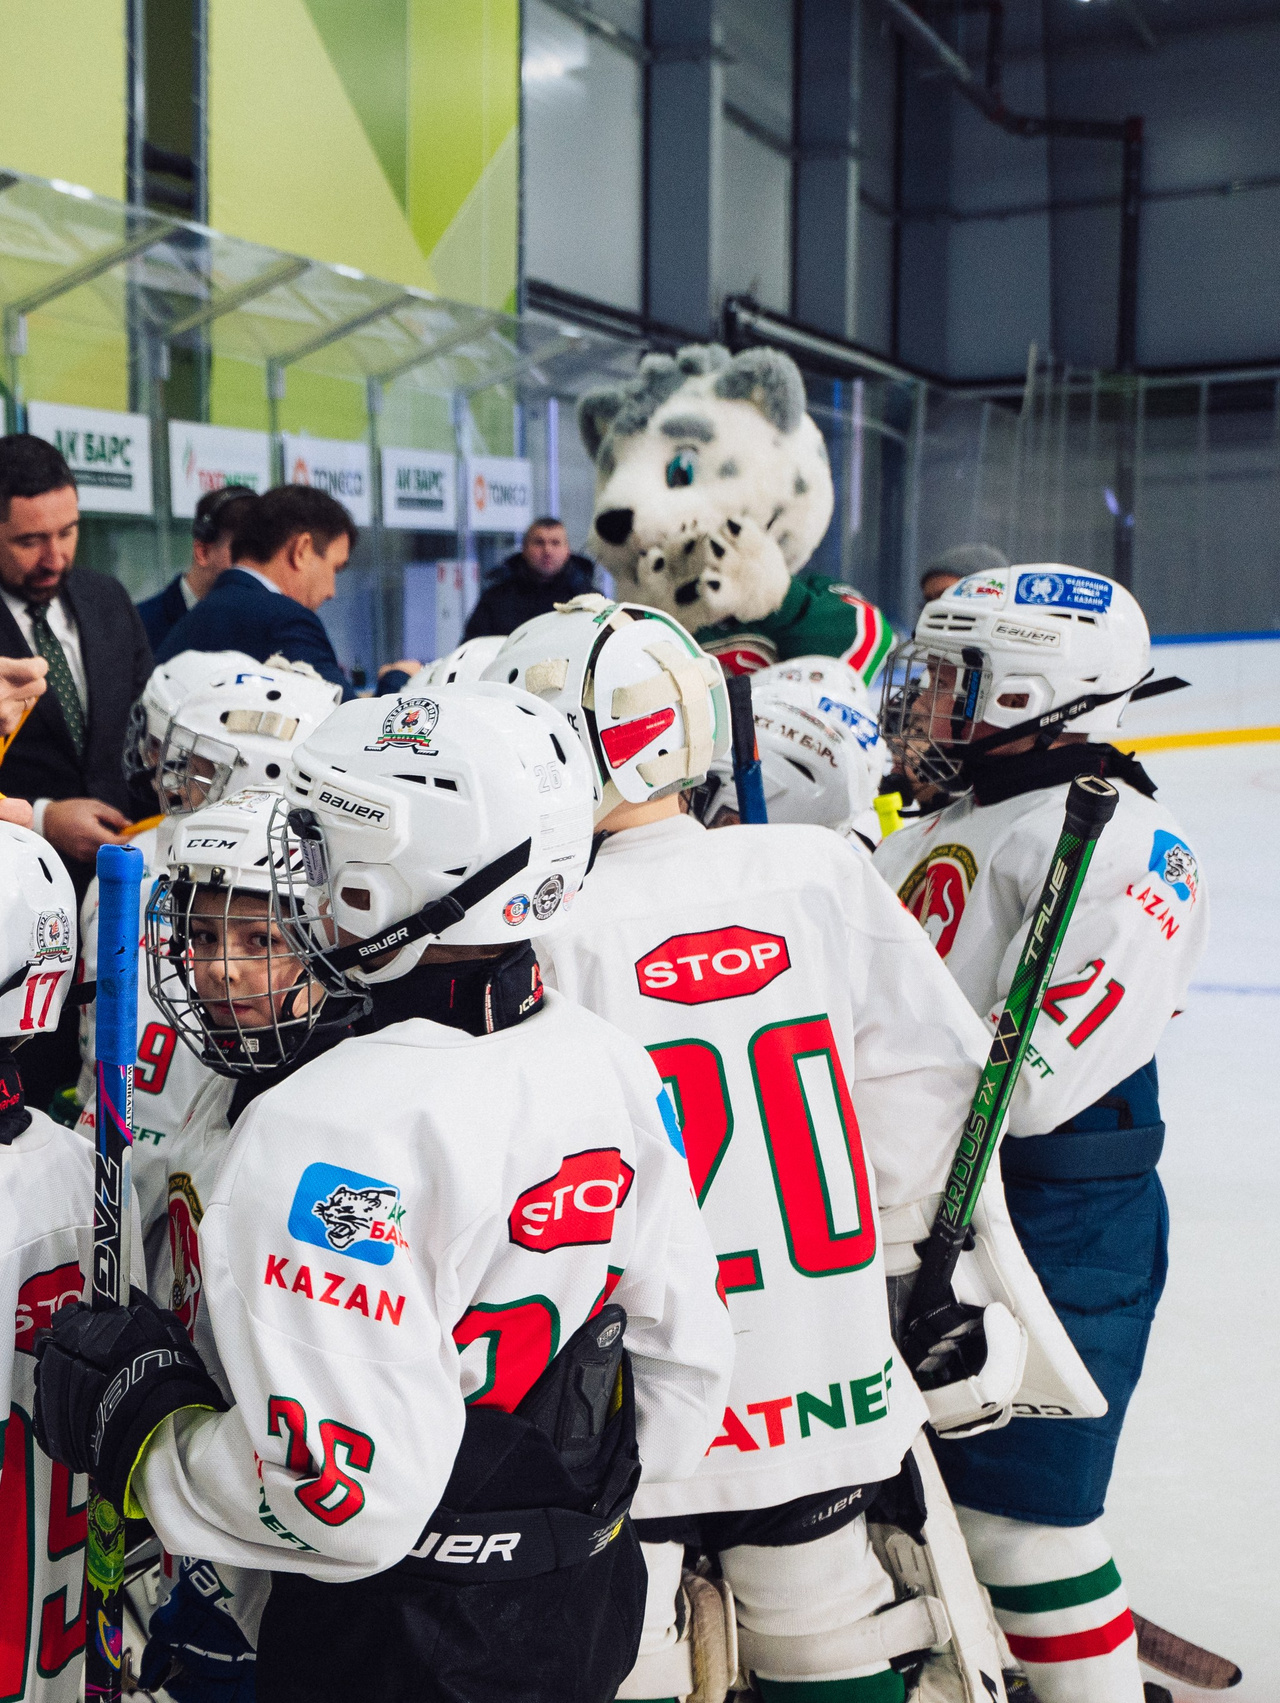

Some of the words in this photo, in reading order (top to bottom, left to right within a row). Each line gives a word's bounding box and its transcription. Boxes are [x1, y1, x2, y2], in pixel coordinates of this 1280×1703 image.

[83, 434, 133, 467] БАРС
[1066, 577, 1109, 592] ФЕДЕРАЦИЯ
[996, 625, 1056, 642] BAUER
[319, 791, 385, 823] BAUER
[186, 839, 238, 850] CCM
[1025, 861, 1068, 965] TRUE
[358, 926, 410, 957] BAUER
[644, 942, 781, 989] STOP
[20, 970, 67, 1030] 17
[1041, 958, 1126, 1050] 21
[522, 1173, 624, 1236] STO
[263, 1254, 407, 1327] KAZAN
[267, 1394, 375, 1527] 26
[407, 1532, 521, 1564] UER
